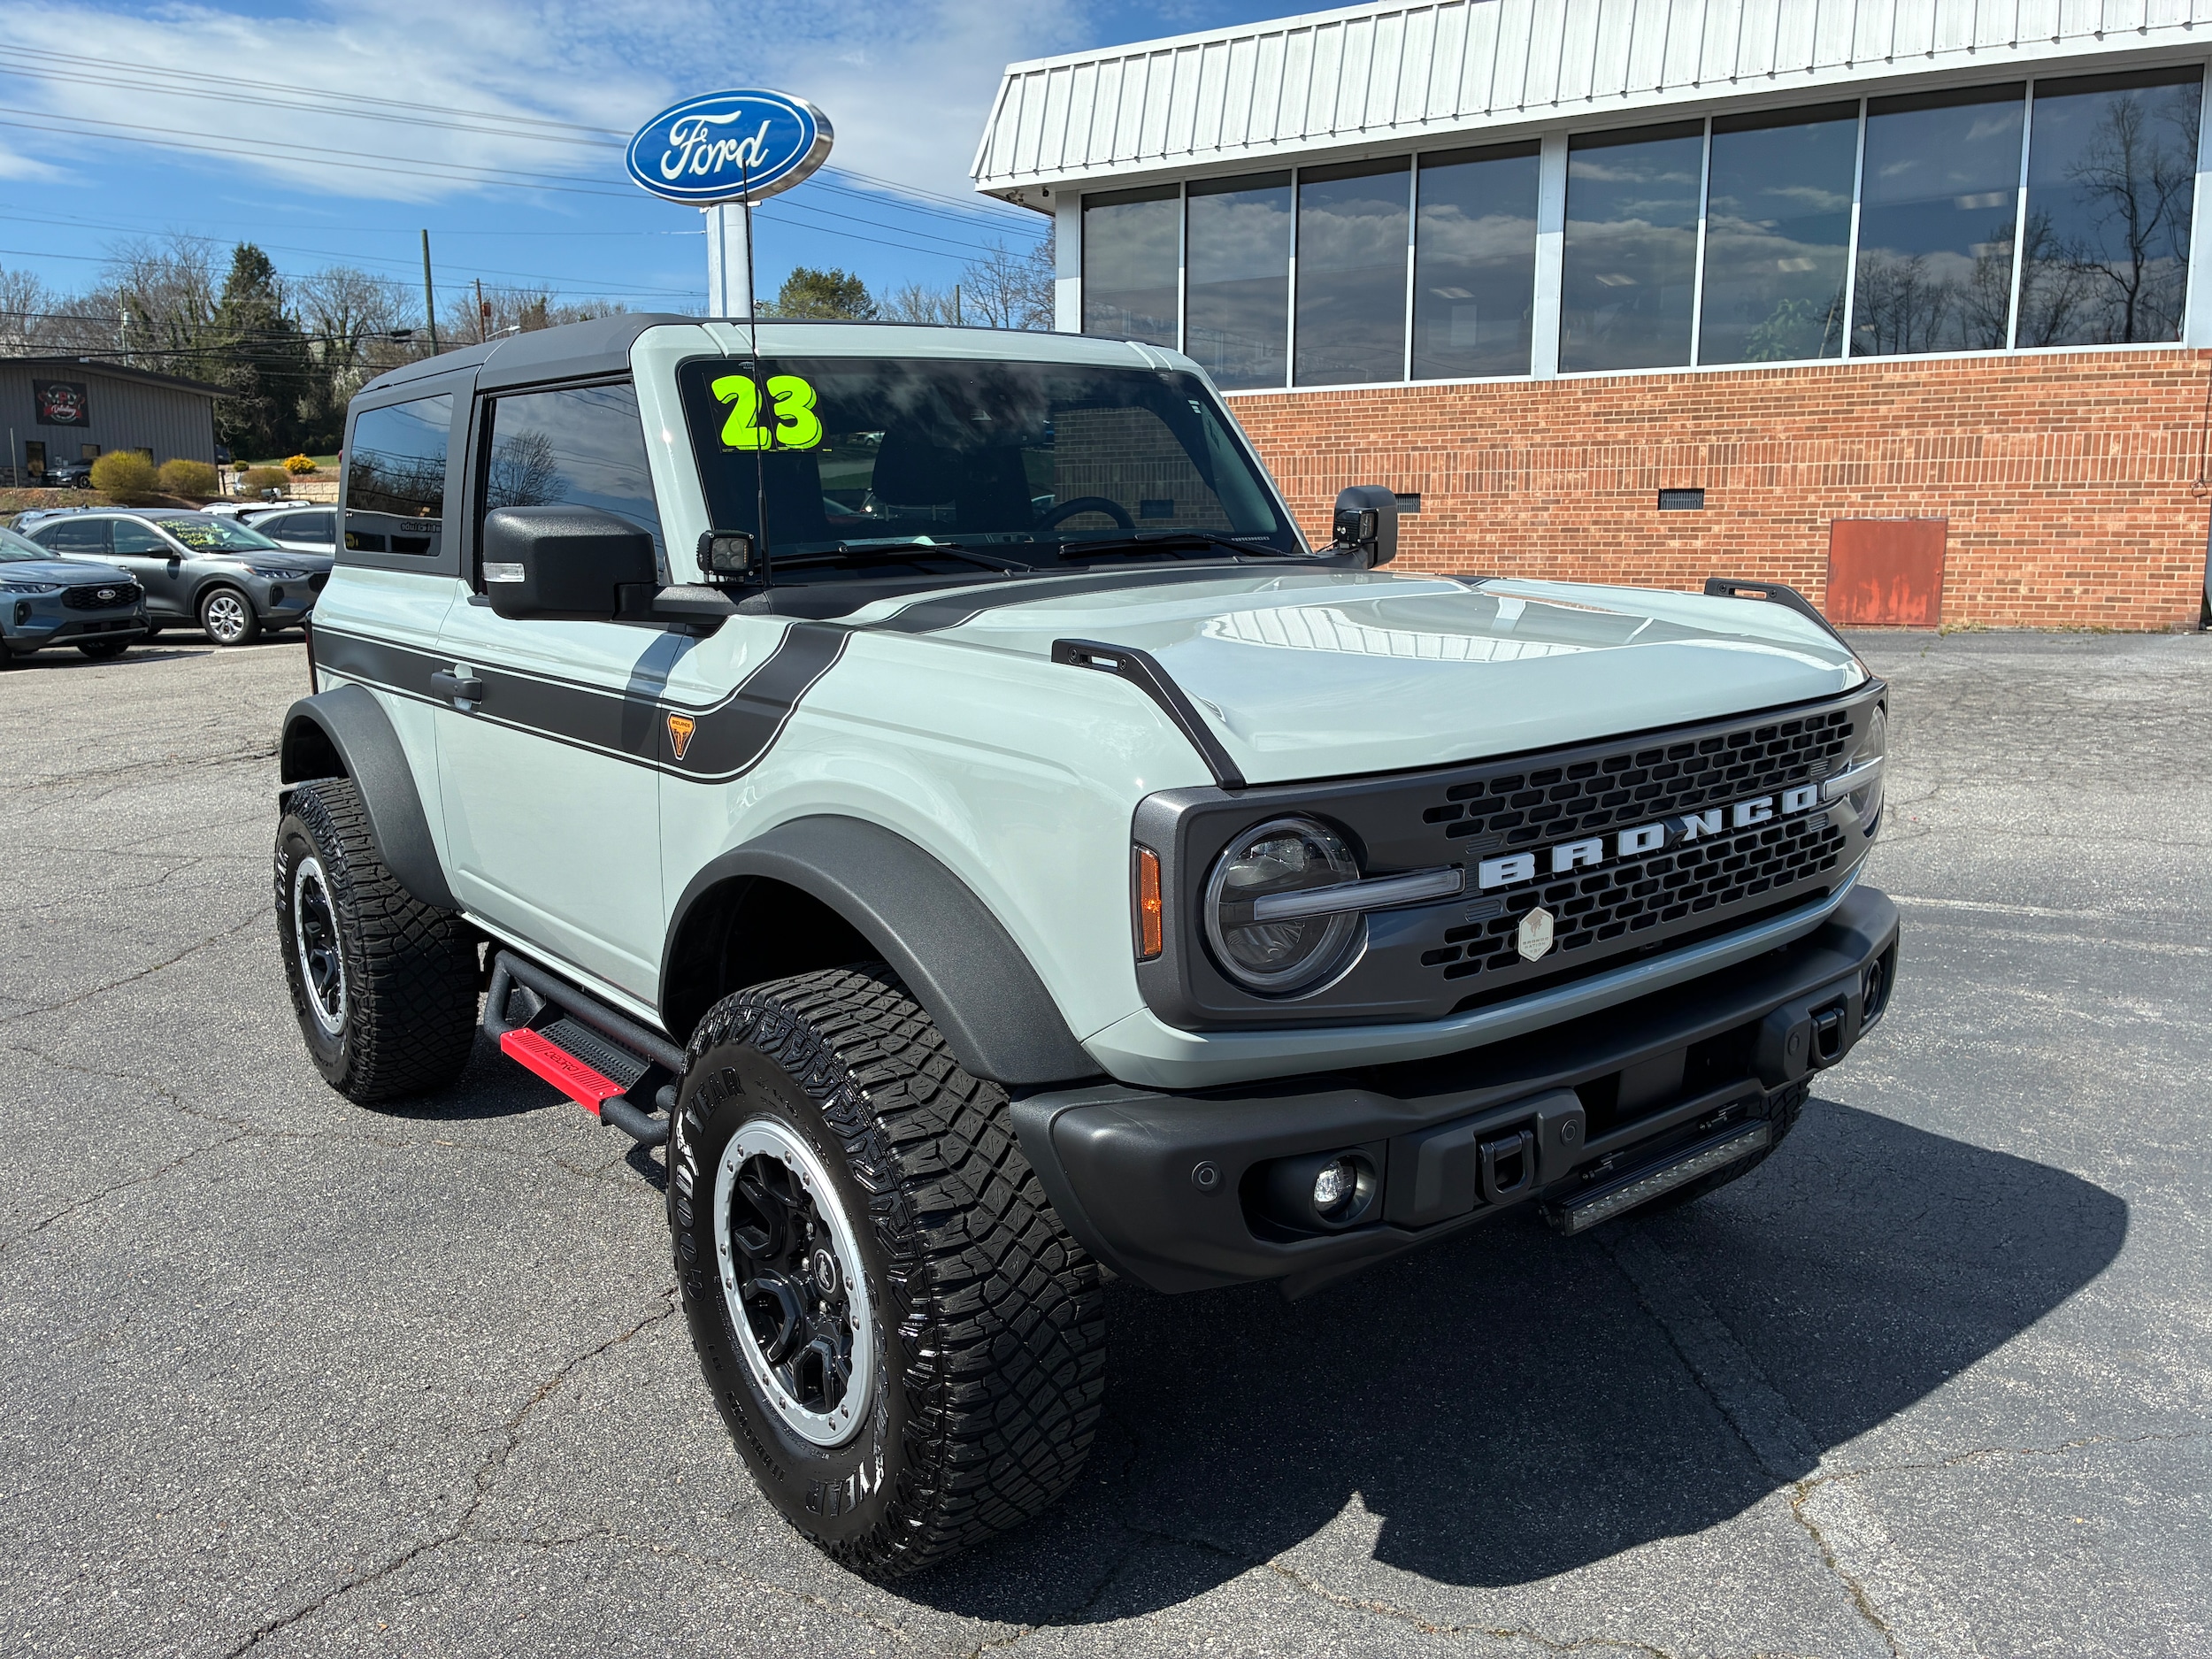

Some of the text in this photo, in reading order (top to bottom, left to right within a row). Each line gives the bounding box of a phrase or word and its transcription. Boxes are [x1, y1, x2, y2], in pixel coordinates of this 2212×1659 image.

[661, 111, 772, 180] Ford
[711, 375, 822, 449] 23
[1479, 784, 1817, 889] BRONCO
